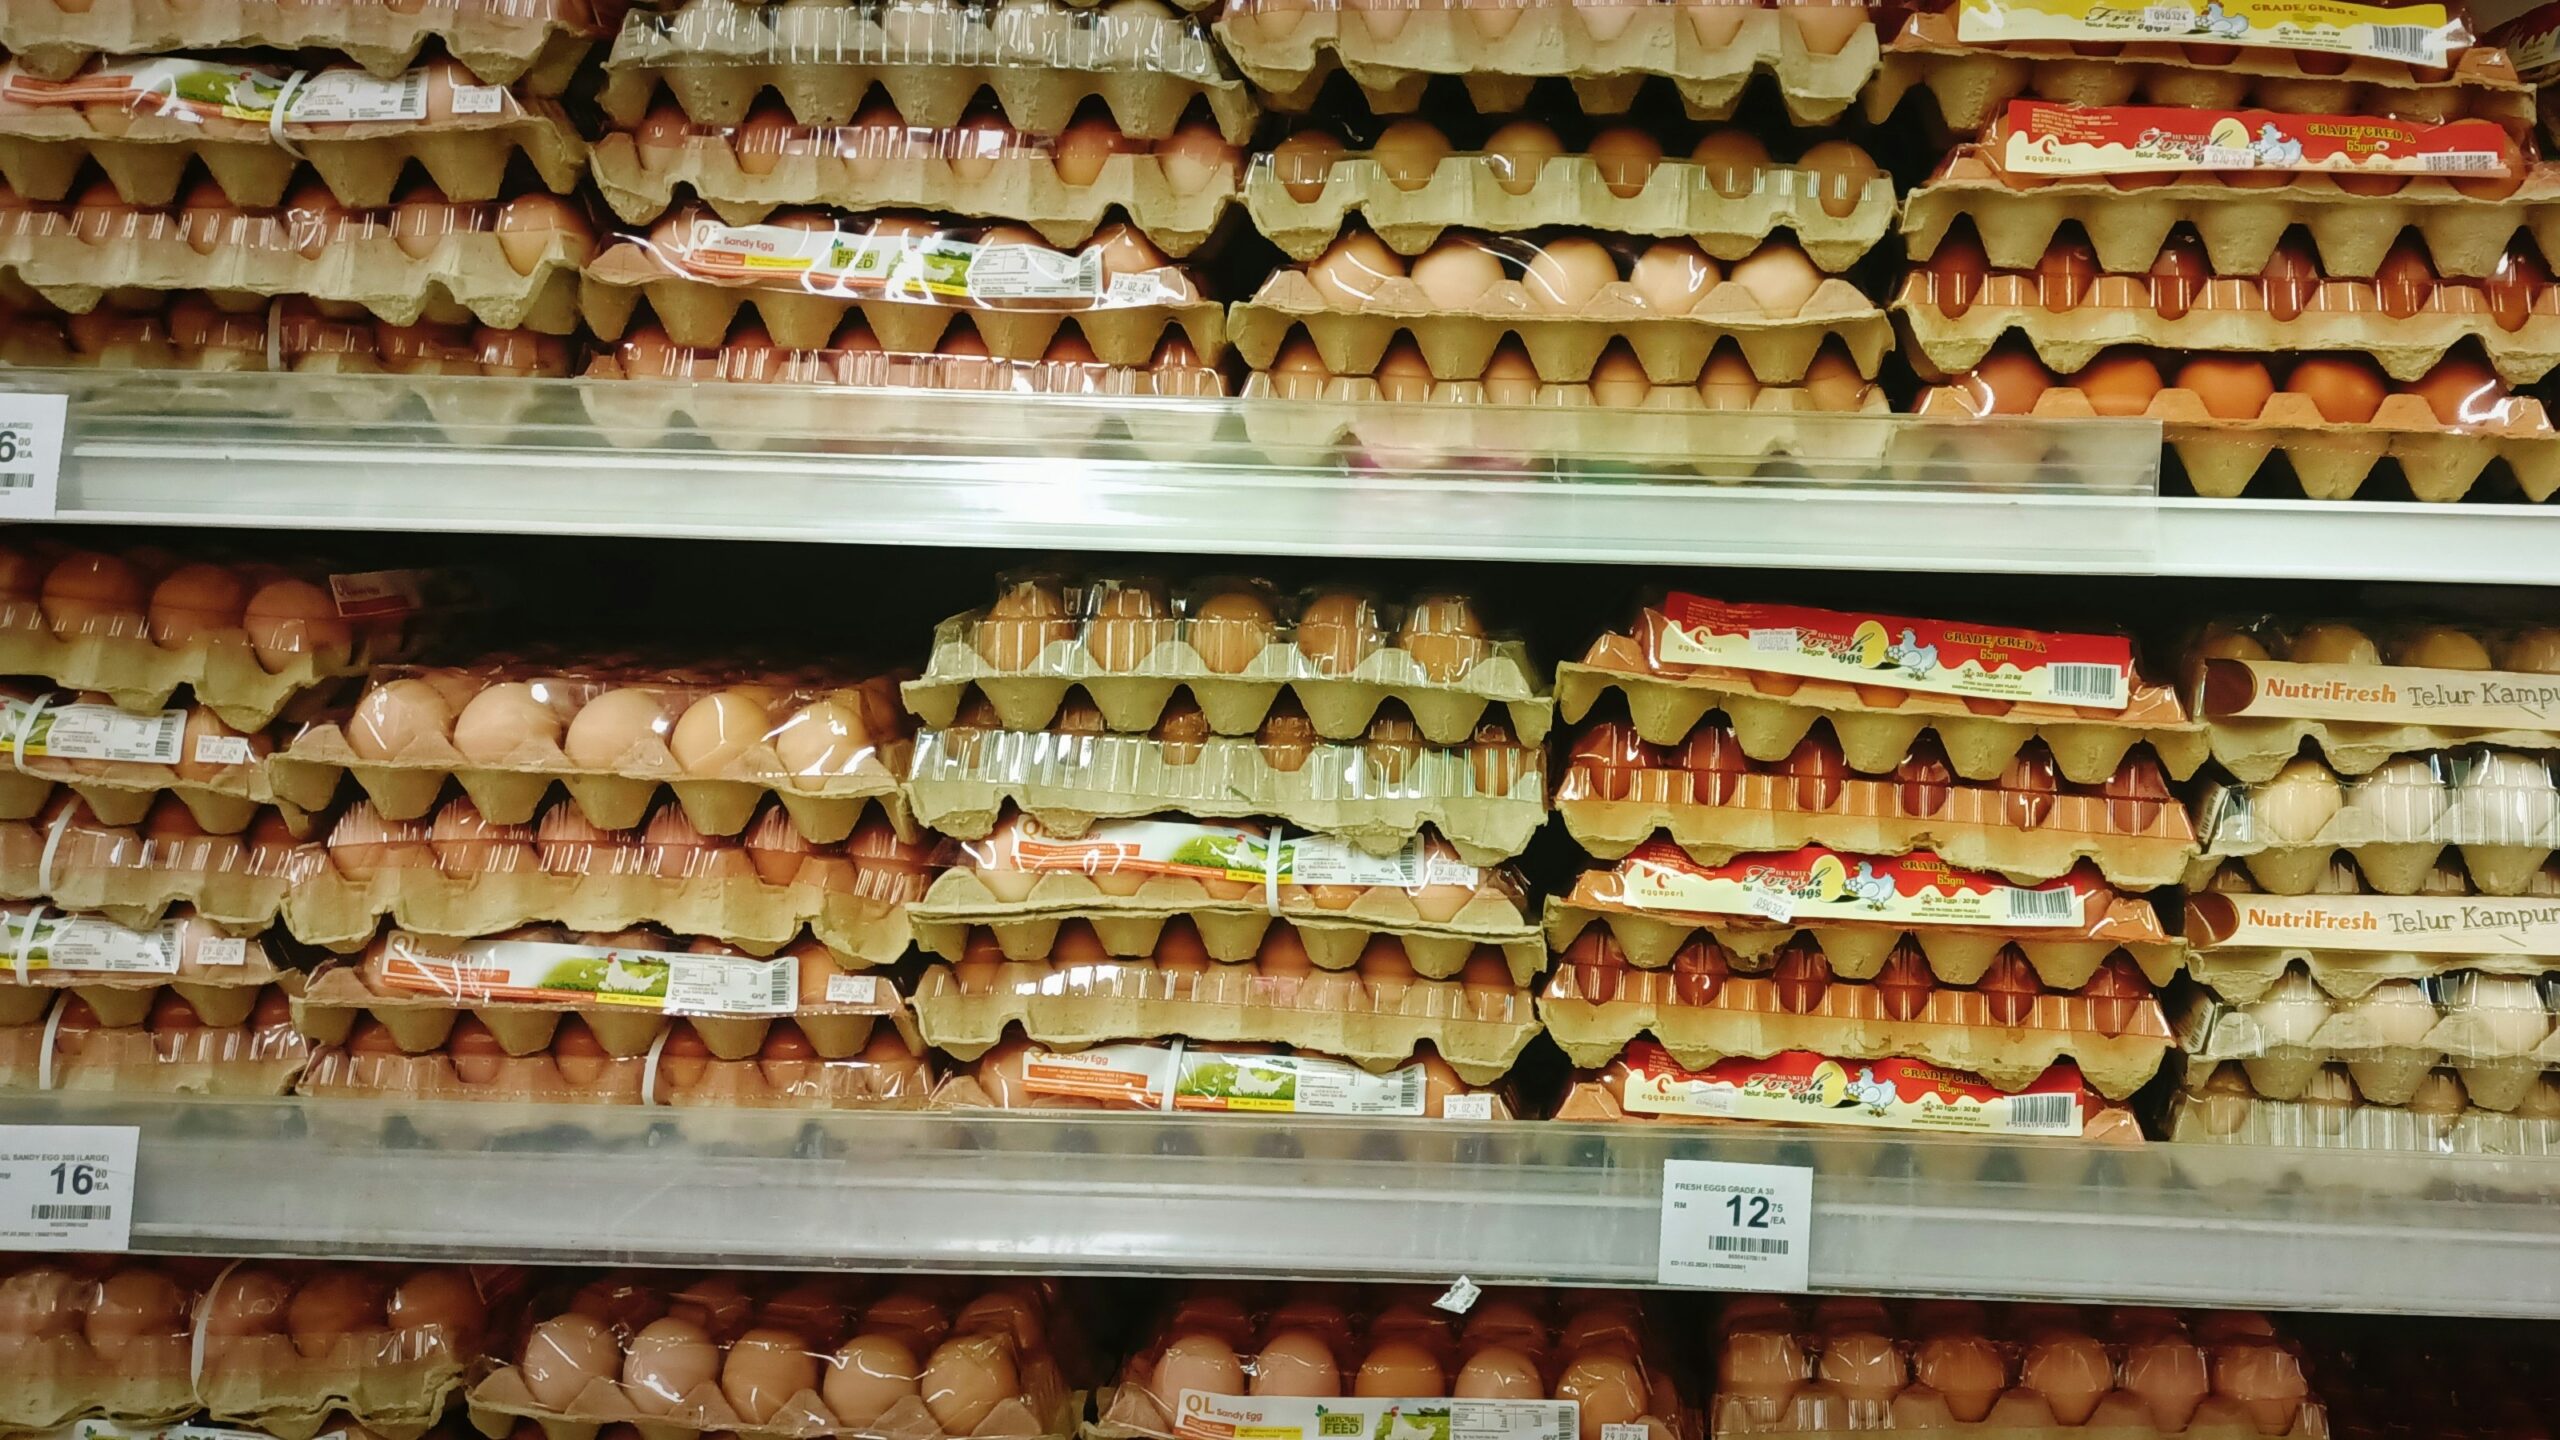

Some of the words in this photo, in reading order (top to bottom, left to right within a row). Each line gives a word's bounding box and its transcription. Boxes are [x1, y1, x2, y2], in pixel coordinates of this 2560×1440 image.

[2085, 6, 2145, 22] Fre
[2251, 3, 2346, 15] GRADE/GRED
[2307, 123, 2403, 141] GRADE/GRED
[2404, 131, 2416, 144] A
[2347, 139, 2377, 153] 65gm
[2156, 151, 2181, 160] Segar
[2188, 155, 2205, 164] eg
[724, 236, 754, 249] Sandy
[756, 240, 775, 252] Egg
[838, 250, 874, 259] NATAL
[1944, 631, 2035, 651] GRADE/GRED
[2035, 642, 2047, 653] A
[1802, 647, 1825, 656] Segar
[1831, 652, 1863, 664] eggs
[1980, 648, 2009, 662] 65gm
[2265, 678, 2397, 703] NutriFresh
[2407, 684, 2476, 707] Telur
[1744, 865, 1832, 887] Fresh
[1937, 874, 1966, 887] 65gm
[1790, 888, 1822, 899] eggs
[2248, 908, 2378, 930] NutriFresh
[2388, 910, 2456, 932] Telur
[1091, 1054, 1109, 1066] Egg
[1744, 1073, 1833, 1092] Fresh
[1938, 1082, 1966, 1095] 65gm
[1763, 1090, 1786, 1099] Segar
[1792, 1092, 1823, 1104] eggs
[50, 1162, 94, 1195] 16
[95, 1169, 108, 1179] 00
[94, 1182, 110, 1191] /EA
[1674, 1183, 1702, 1191] FRESH
[1703, 1185, 1727, 1193] EGGS
[1727, 1186, 1756, 1195] GRADE
[1765, 1188, 1775, 1196] 30
[1674, 1201, 1687, 1209] RM
[1726, 1194, 1770, 1228] 12
[1771, 1203, 1784, 1213] 75
[1770, 1216, 1786, 1225] /EA
[1186, 1394, 1215, 1416] QL
[1216, 1408, 1245, 1421] Sandy
[1246, 1411, 1263, 1422] Egg
[1324, 1423, 1359, 1434] FEED
